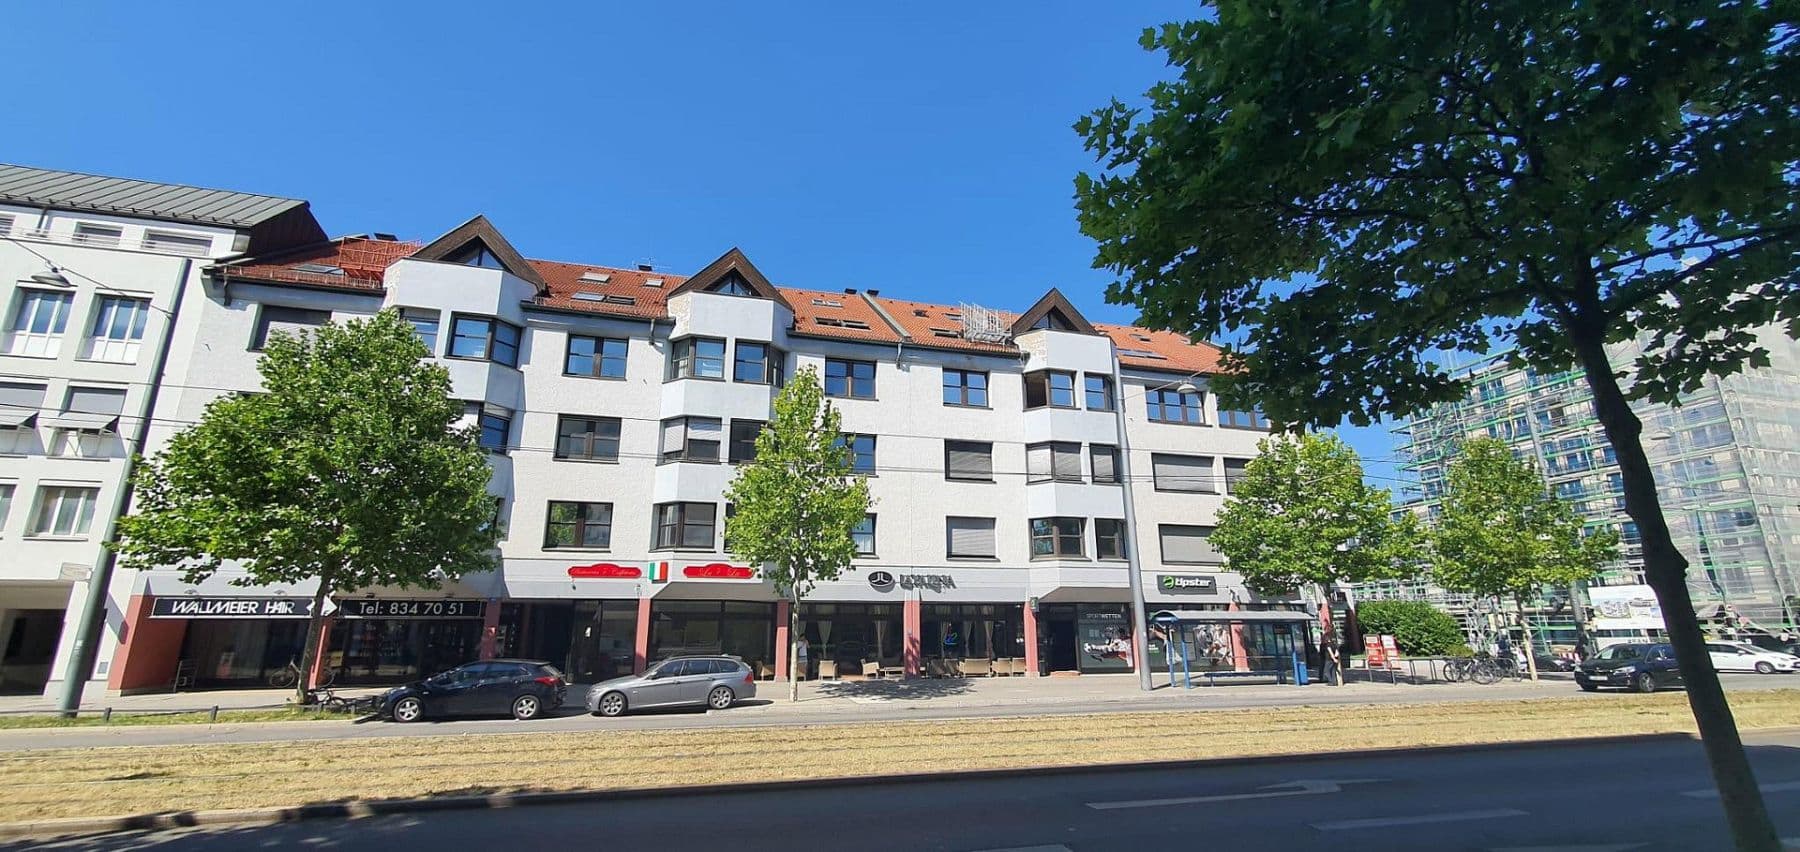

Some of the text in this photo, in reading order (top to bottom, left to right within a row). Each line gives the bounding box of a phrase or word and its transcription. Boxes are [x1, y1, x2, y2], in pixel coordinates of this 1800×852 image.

[1175, 578, 1211, 589] tipster
[171, 601, 295, 613] WALLMEIER HAIR
[359, 602, 463, 614] Tel: 834 70 51
